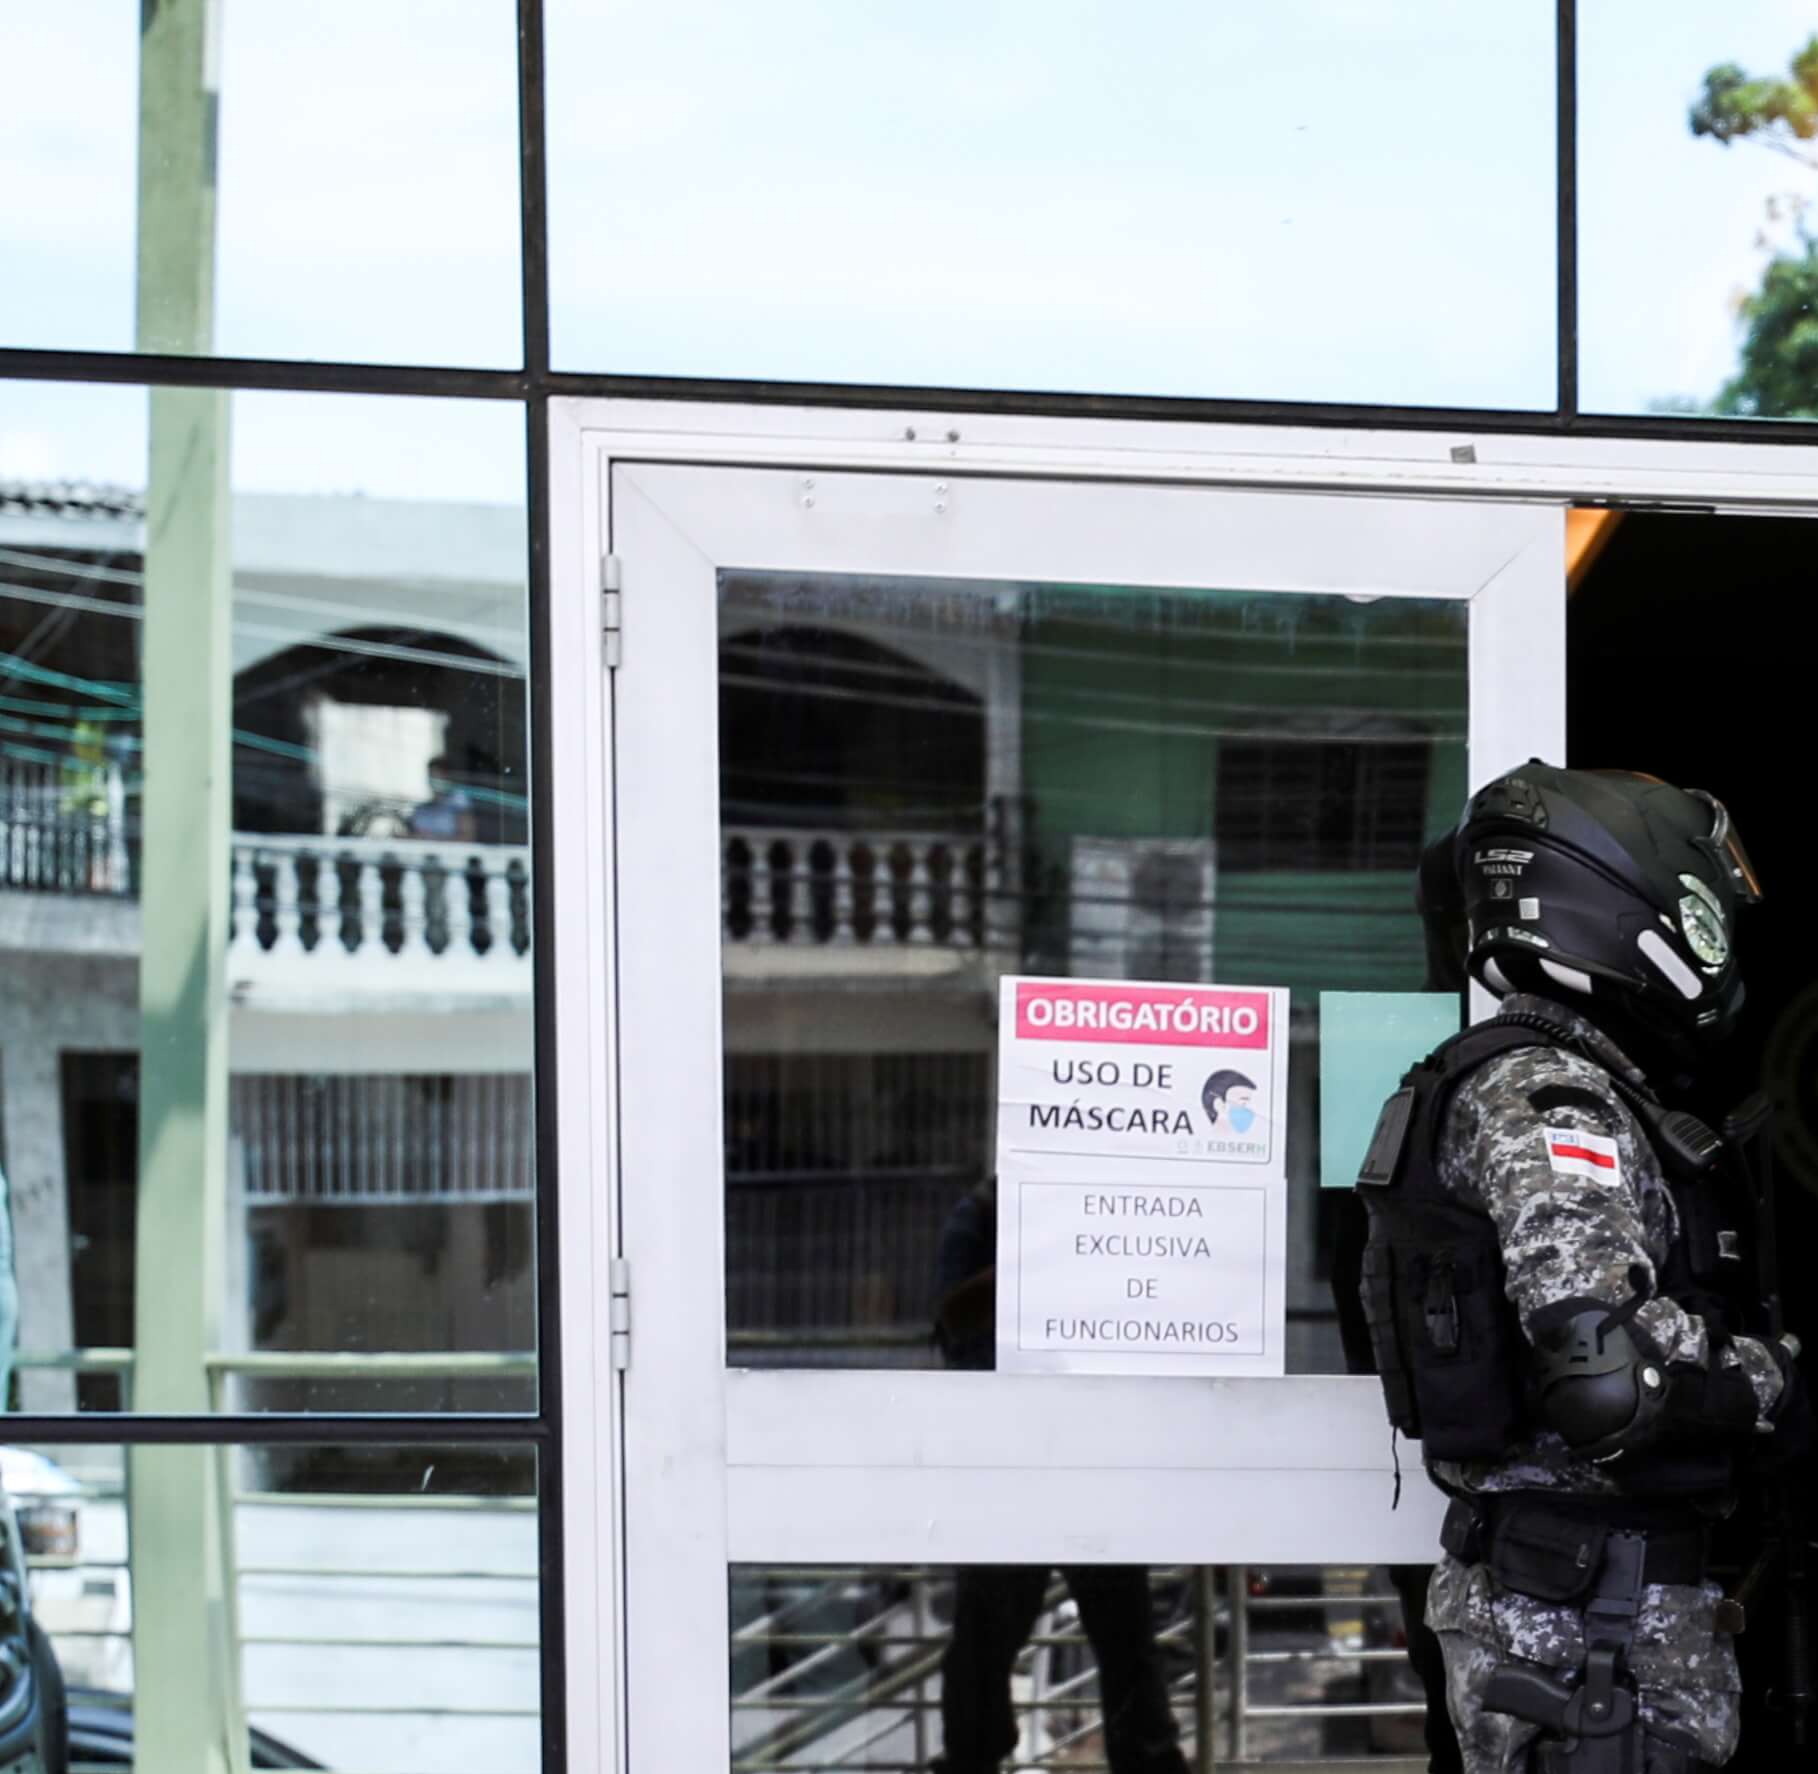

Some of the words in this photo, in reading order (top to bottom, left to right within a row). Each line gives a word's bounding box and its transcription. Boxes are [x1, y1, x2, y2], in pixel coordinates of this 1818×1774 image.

[1474, 849, 1535, 864] LS2
[1026, 997, 1259, 1035] OBRIGATÓRIO
[1053, 1060, 1120, 1087] USO
[1132, 1063, 1173, 1089] DE
[1029, 1099, 1194, 1135] MÁSCARA
[1083, 1194, 1203, 1218] ENTRADA
[1075, 1234, 1211, 1258] EXCLUSIVA
[1126, 1278, 1159, 1299] DE
[1045, 1318, 1239, 1343] FUNCIONARIOS
